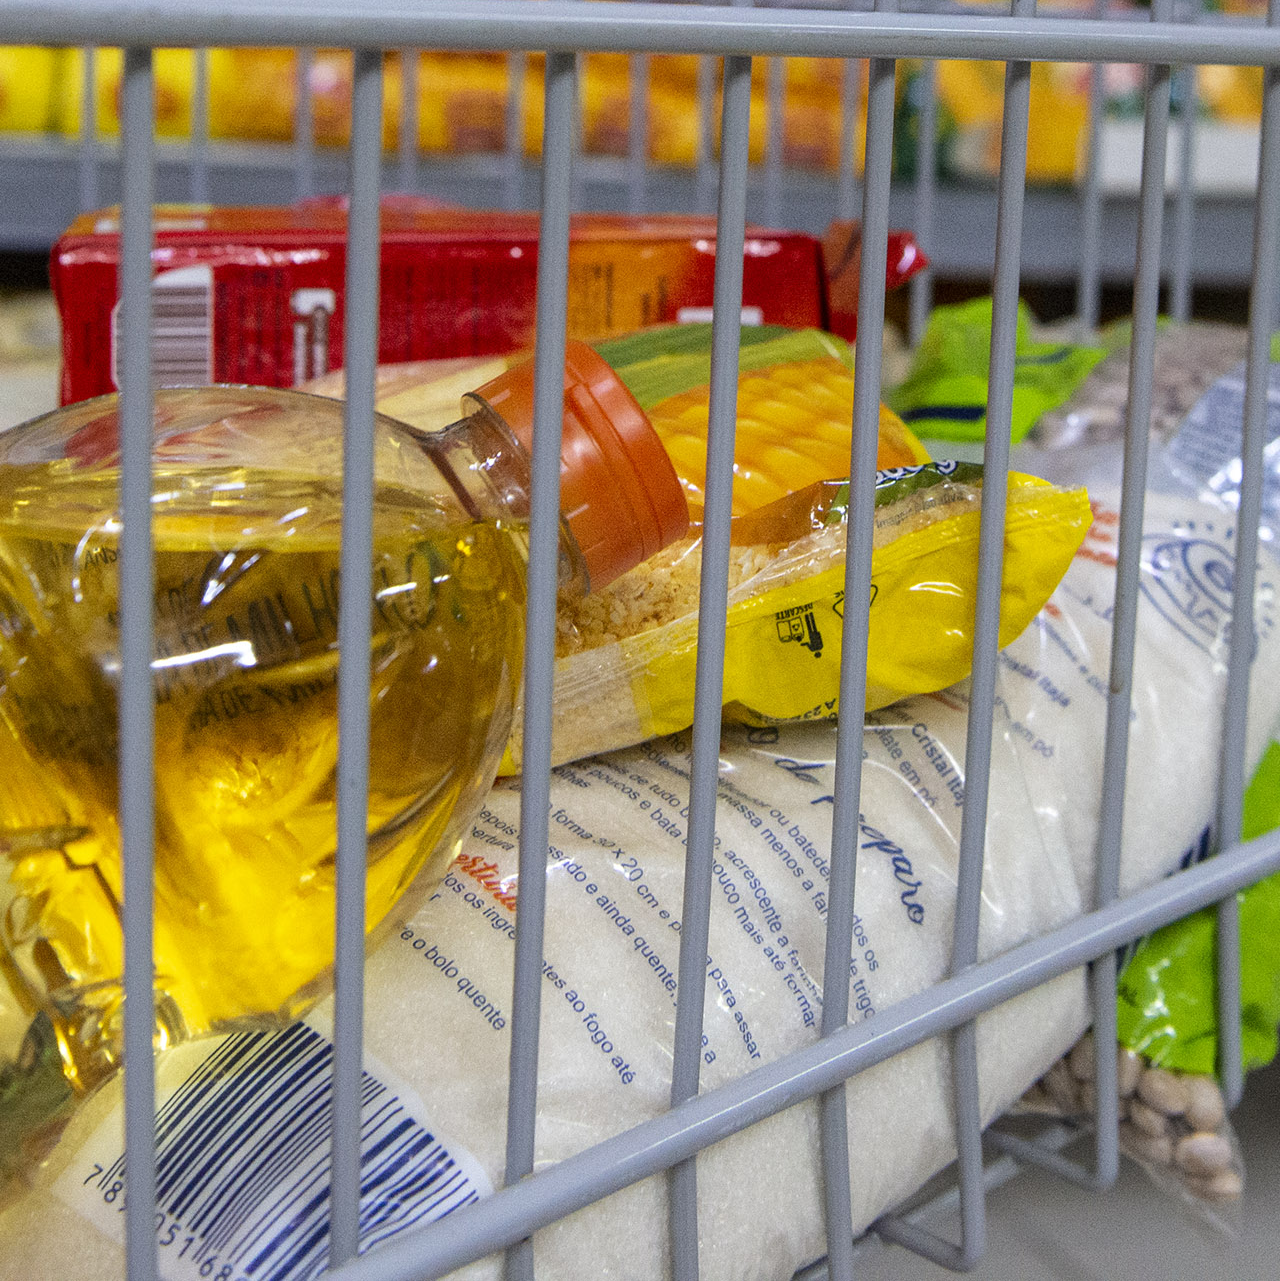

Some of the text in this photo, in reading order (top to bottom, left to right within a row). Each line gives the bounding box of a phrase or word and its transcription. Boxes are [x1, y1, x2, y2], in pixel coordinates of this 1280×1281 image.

[899, 760, 921, 786] em
[912, 723, 953, 778] Cristal
[552, 809, 593, 840] forma
[612, 847, 625, 859] x
[620, 857, 644, 882] 20
[637, 884, 659, 909] cm
[659, 909, 670, 919] e
[708, 968, 736, 1008] para
[734, 1011, 761, 1060] assar
[586, 768, 640, 800] poucos
[639, 799, 651, 810] e
[650, 808, 681, 838] bata
[734, 905, 764, 945] mais
[762, 946, 785, 971] até
[783, 973, 816, 1029] formar
[649, 783, 681, 808] tudo
[724, 849, 782, 933] acrescente
[777, 935, 789, 948] a
[761, 828, 804, 878] menos
[802, 879, 814, 892] a
[770, 808, 789, 827] ou
[864, 949, 879, 972] os
[412, 937, 506, 1031] o bolo quente
[463, 891, 485, 909] os
[565, 989, 585, 1012] ao
[582, 1012, 614, 1053] fogo
[611, 1055, 636, 1085] até
[585, 882, 598, 895] e
[596, 895, 635, 936] ainda
[634, 936, 678, 998] quente,
[704, 1050, 716, 1064] a
